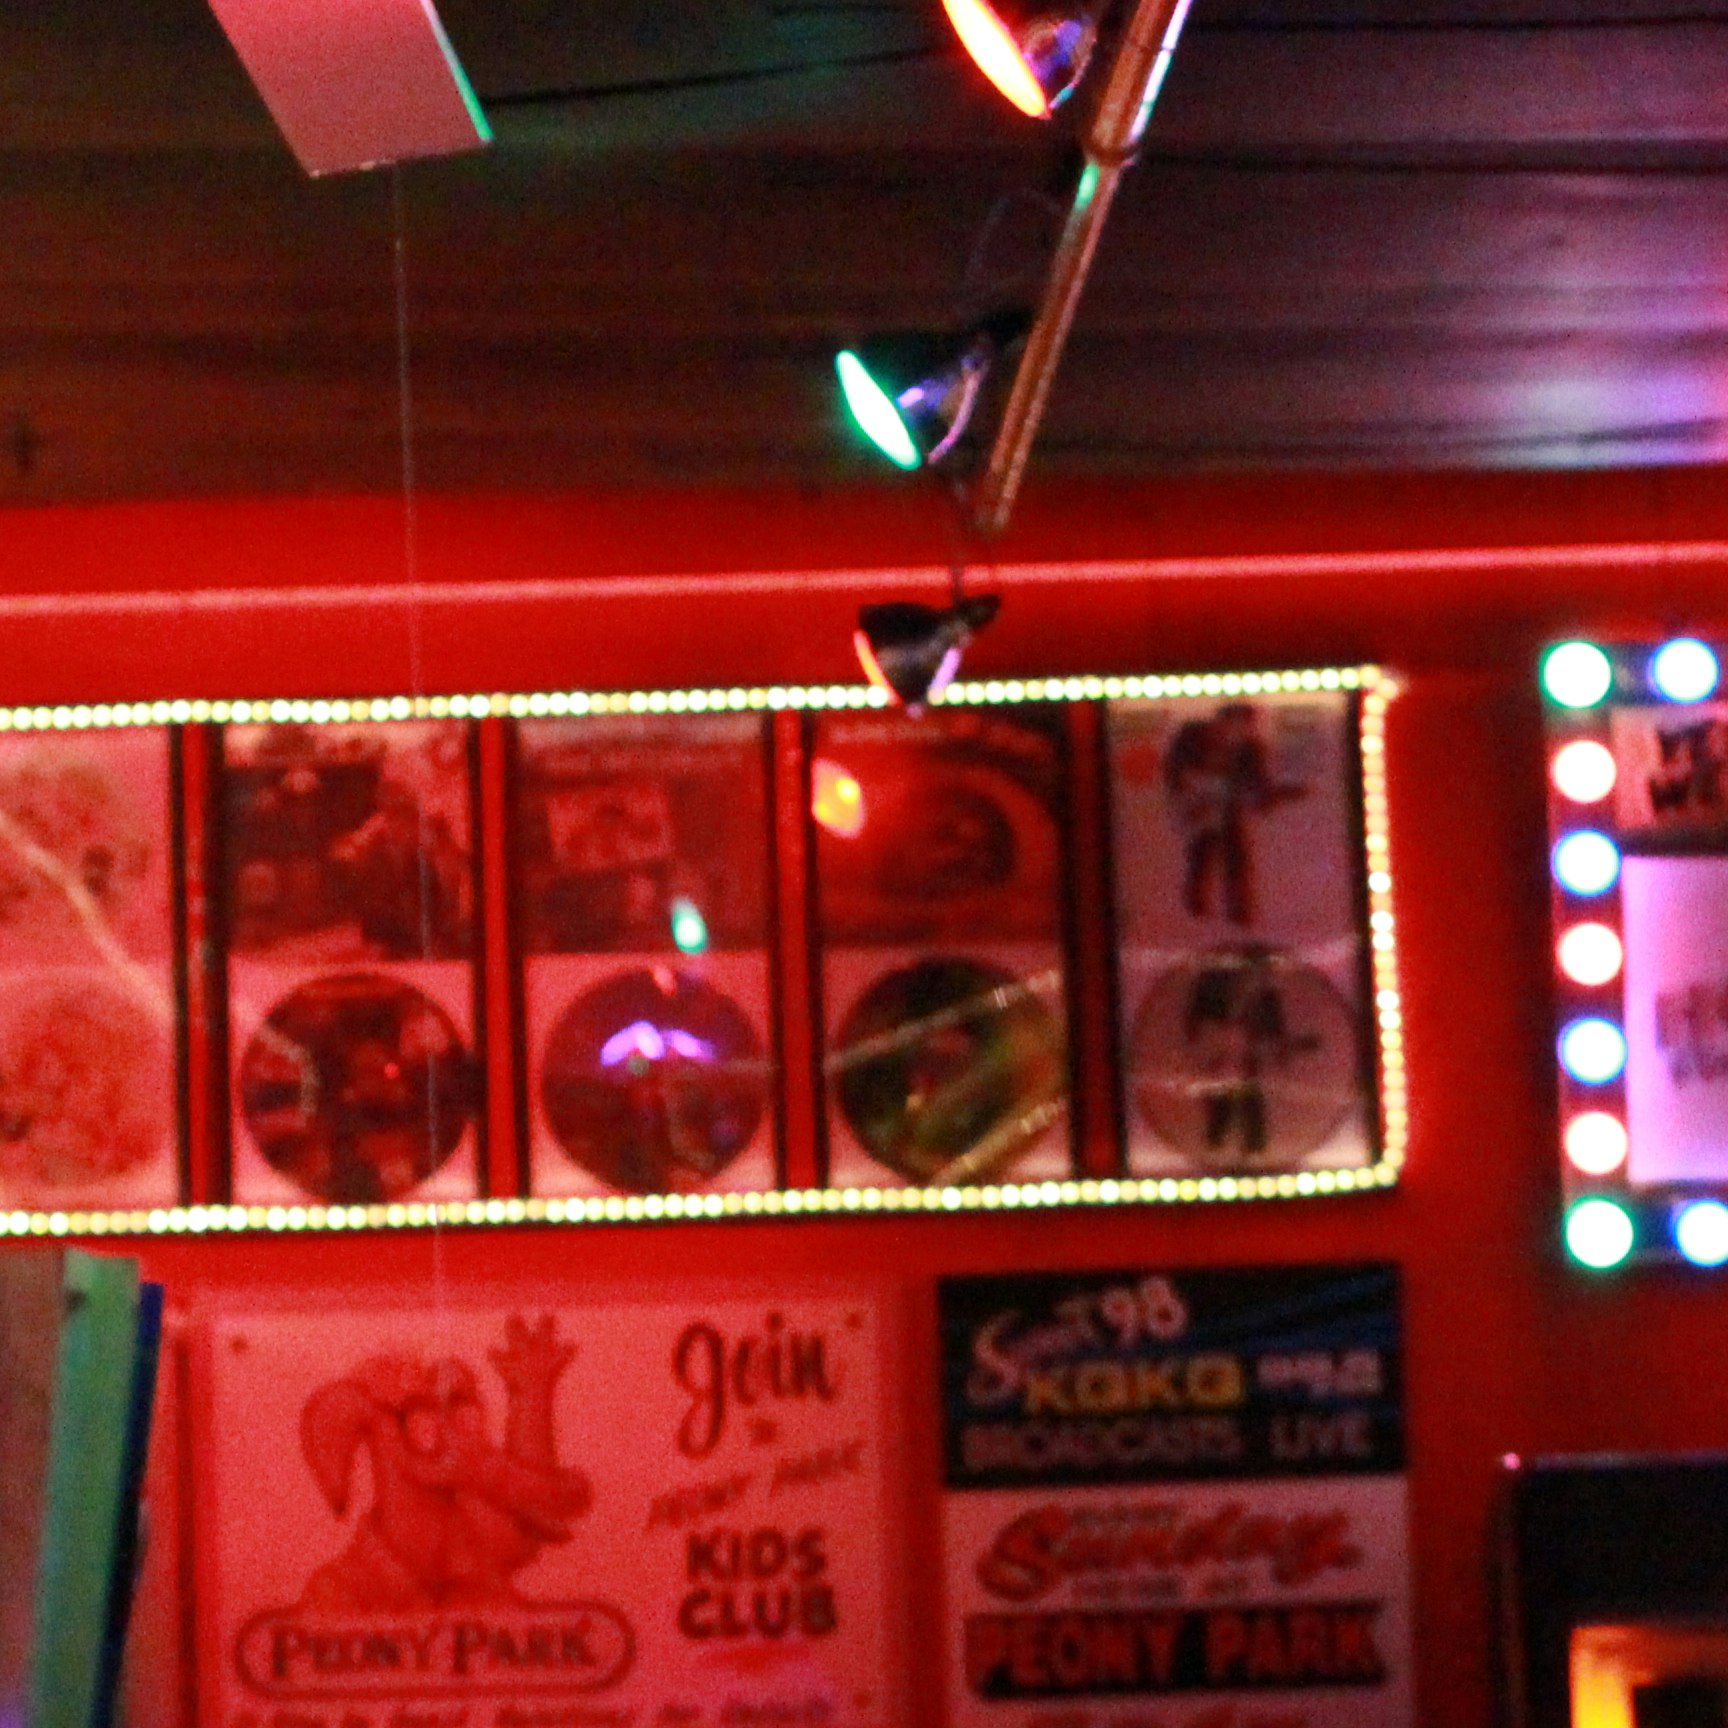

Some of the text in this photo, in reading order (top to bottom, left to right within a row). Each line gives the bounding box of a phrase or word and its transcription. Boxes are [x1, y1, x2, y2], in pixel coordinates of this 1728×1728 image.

[1101, 1274, 1189, 1348] 98
[670, 1311, 846, 1462] Join
[960, 1409, 1376, 1472] BROADCASTS LIVE
[685, 1524, 830, 1583] KIDS
[974, 1501, 1365, 1602] Sunday
[675, 1584, 841, 1642] CLUB
[974, 1604, 1378, 1688] PEONY PARK
[448, 1619, 601, 1678] PARK
